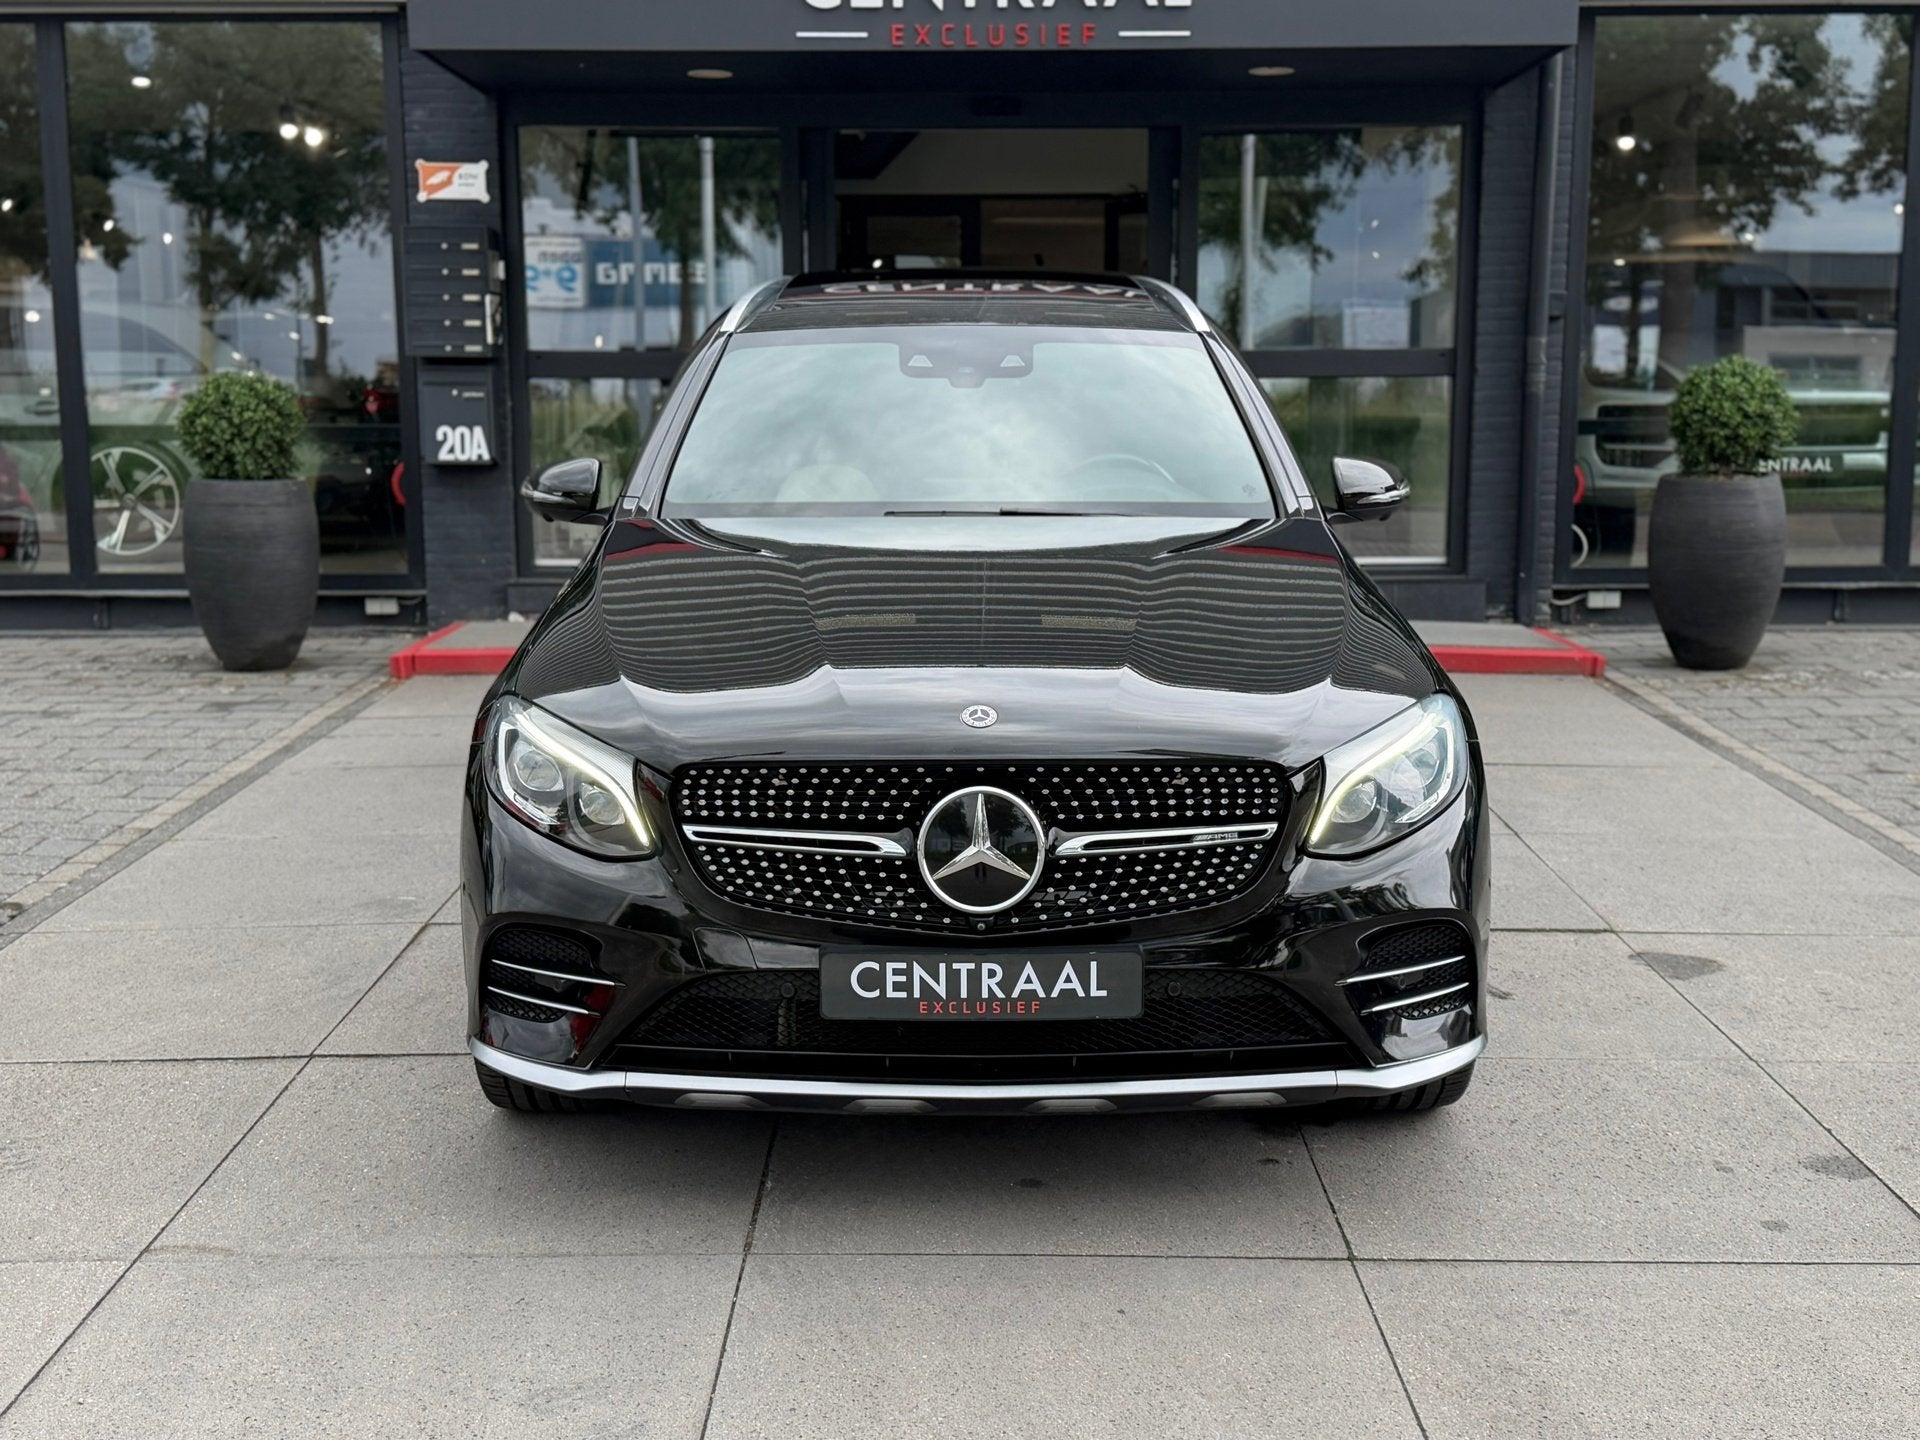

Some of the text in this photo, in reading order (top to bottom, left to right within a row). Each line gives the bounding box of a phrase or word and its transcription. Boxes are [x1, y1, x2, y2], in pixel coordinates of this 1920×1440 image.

[890, 23, 1097, 48] EXCLUSIEF
[436, 424, 491, 462] 20A
[1755, 457, 1834, 473] ENTRAAL
[850, 959, 1108, 1000] CENTRAAL
[919, 1001, 1041, 1014] EXCLUSIEF
